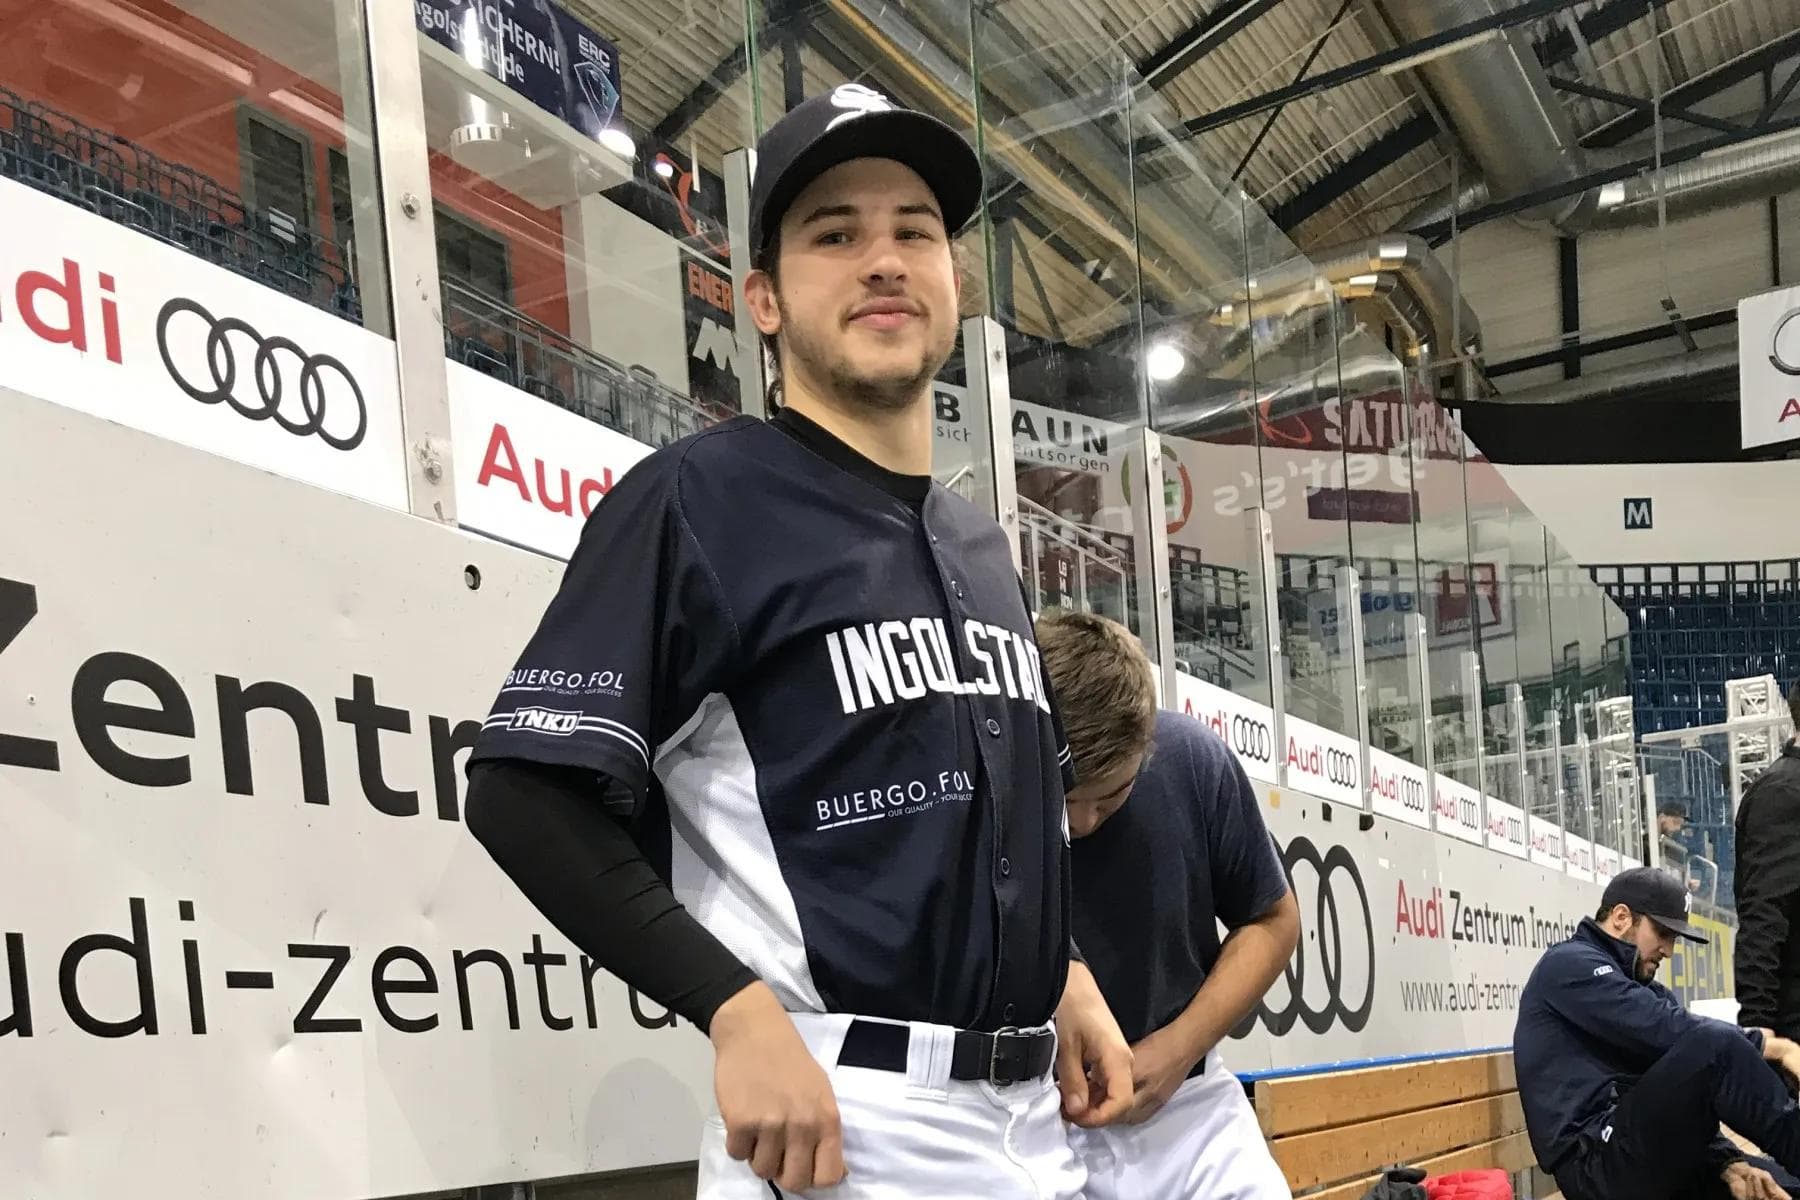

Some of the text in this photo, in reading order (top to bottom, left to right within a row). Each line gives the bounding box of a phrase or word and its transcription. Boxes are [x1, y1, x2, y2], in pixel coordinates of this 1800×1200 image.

[578, 33, 611, 68] ERC
[0, 256, 123, 365] di
[1626, 502, 1651, 526] M
[506, 668, 625, 690] BUERGO.FOL
[514, 709, 580, 733] TNKD
[1287, 735, 1324, 777] Audi
[1372, 765, 1400, 803] Audi
[1435, 788, 1458, 821] Audi
[1396, 878, 1445, 939] Audi
[1449, 890, 1528, 948] Zentrum
